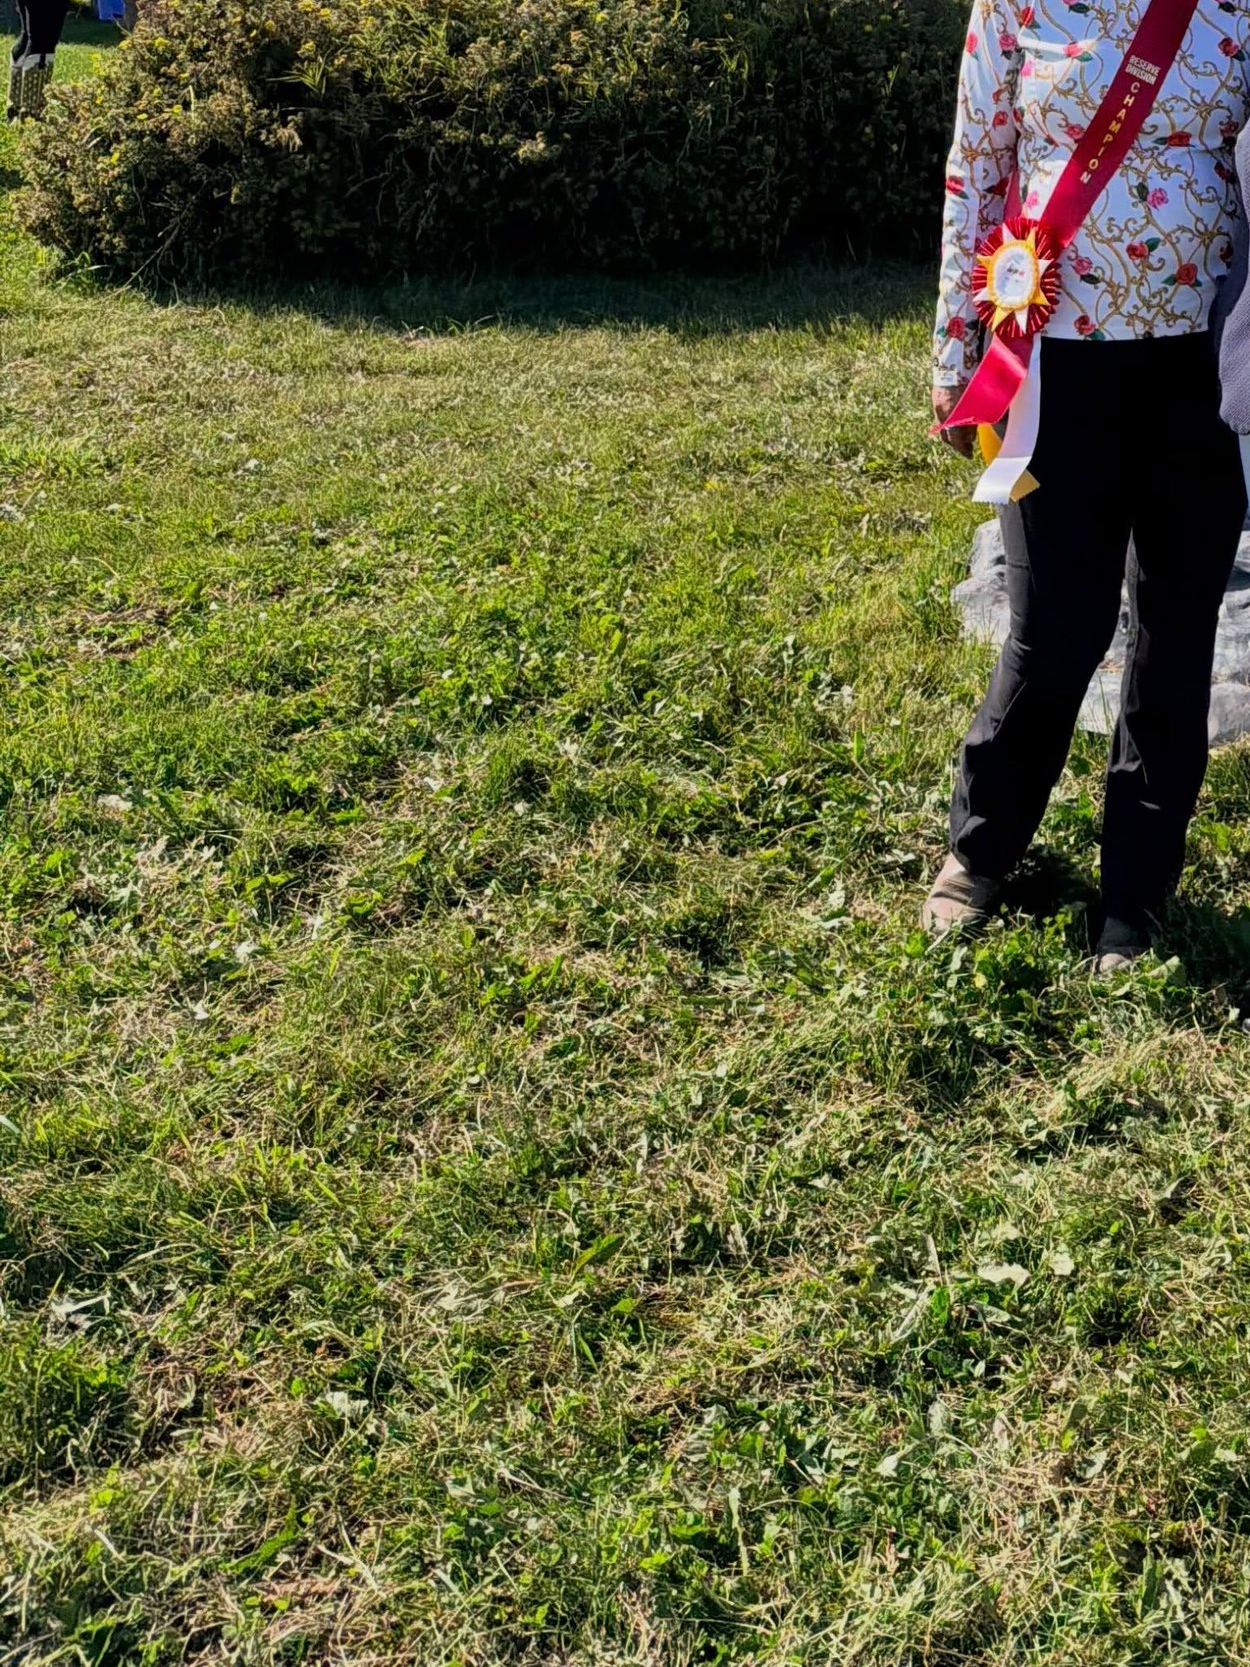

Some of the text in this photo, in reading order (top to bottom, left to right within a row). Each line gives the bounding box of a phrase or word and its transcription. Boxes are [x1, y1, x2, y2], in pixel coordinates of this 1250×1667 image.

[1125, 63, 1158, 86] DIVISION
[1129, 55, 1161, 77] RESERVE
[1080, 82, 1141, 184] CHAMPION
